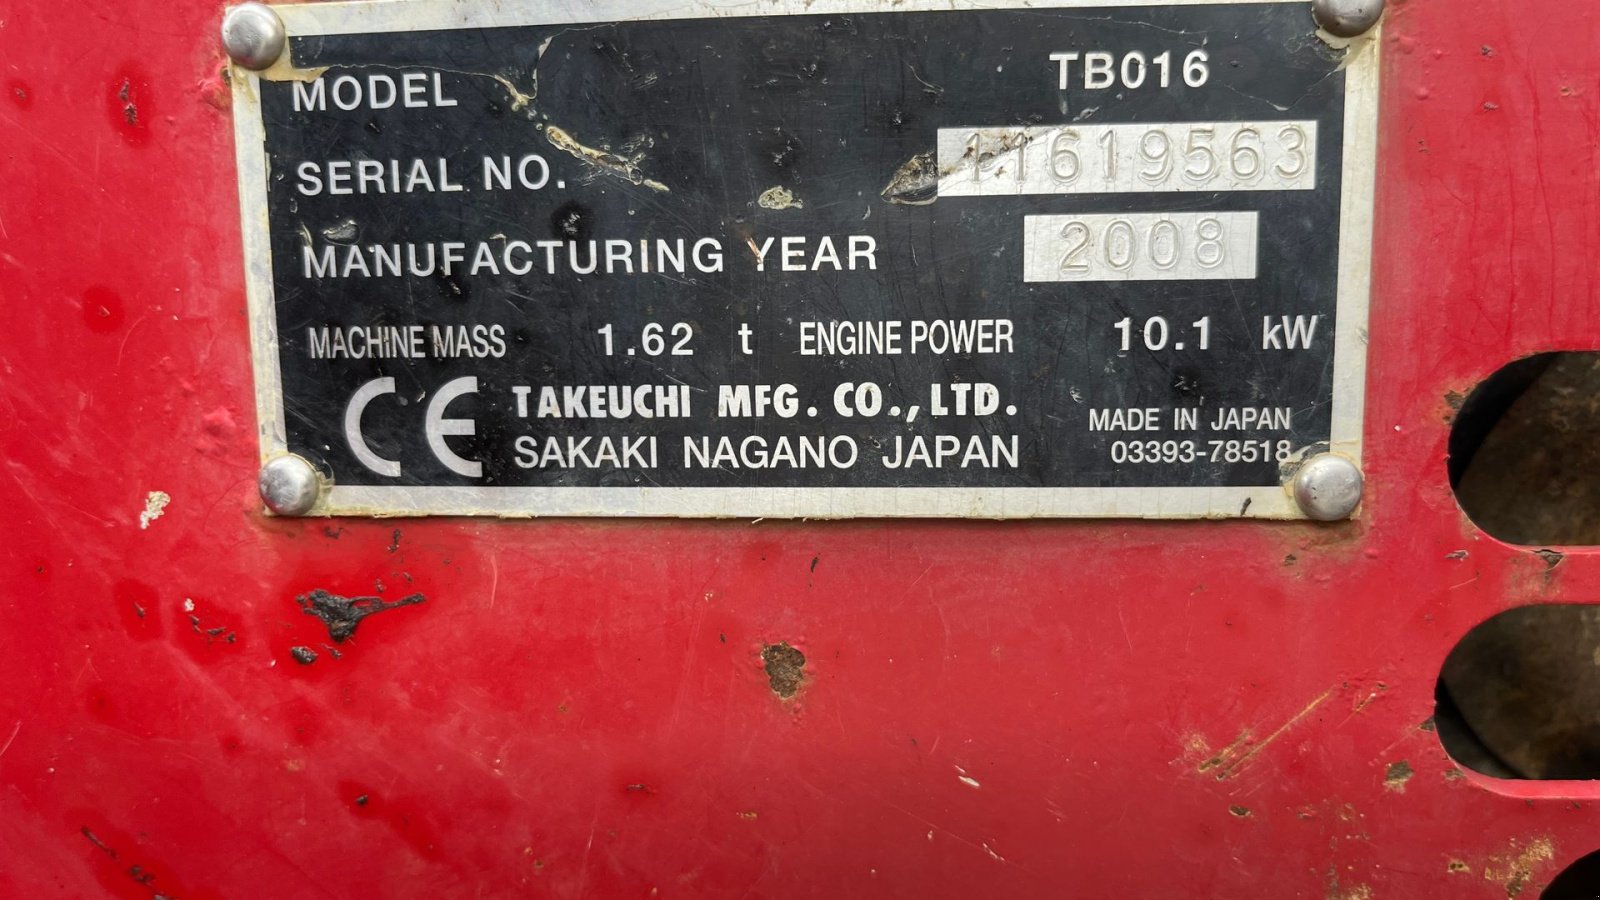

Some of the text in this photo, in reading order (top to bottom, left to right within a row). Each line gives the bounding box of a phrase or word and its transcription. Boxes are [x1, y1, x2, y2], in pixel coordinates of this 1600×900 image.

[1049, 50, 1210, 90] TB016
[292, 72, 458, 112] MODEL
[966, 125, 1309, 184] 11619563
[296, 155, 567, 196] SERIAL NO.
[303, 235, 878, 279] MANUFACTURING YEAR
[1058, 218, 1226, 273] 2008
[309, 324, 506, 359] MACHINE MASS
[598, 322, 754, 356] 1.62 t
[800, 319, 1014, 355] ENGINE POWER
[1113, 315, 1317, 351] 10.1 kW
[512, 385, 691, 418] TAKEUCHI
[718, 384, 818, 418] MFG.
[344, 376, 484, 478] CE
[1089, 408, 1291, 431] MADE IN JAPAN
[514, 435, 1020, 469] SAKAKI NAGANO JAPAN
[1110, 441, 1291, 464] 03393-78518
